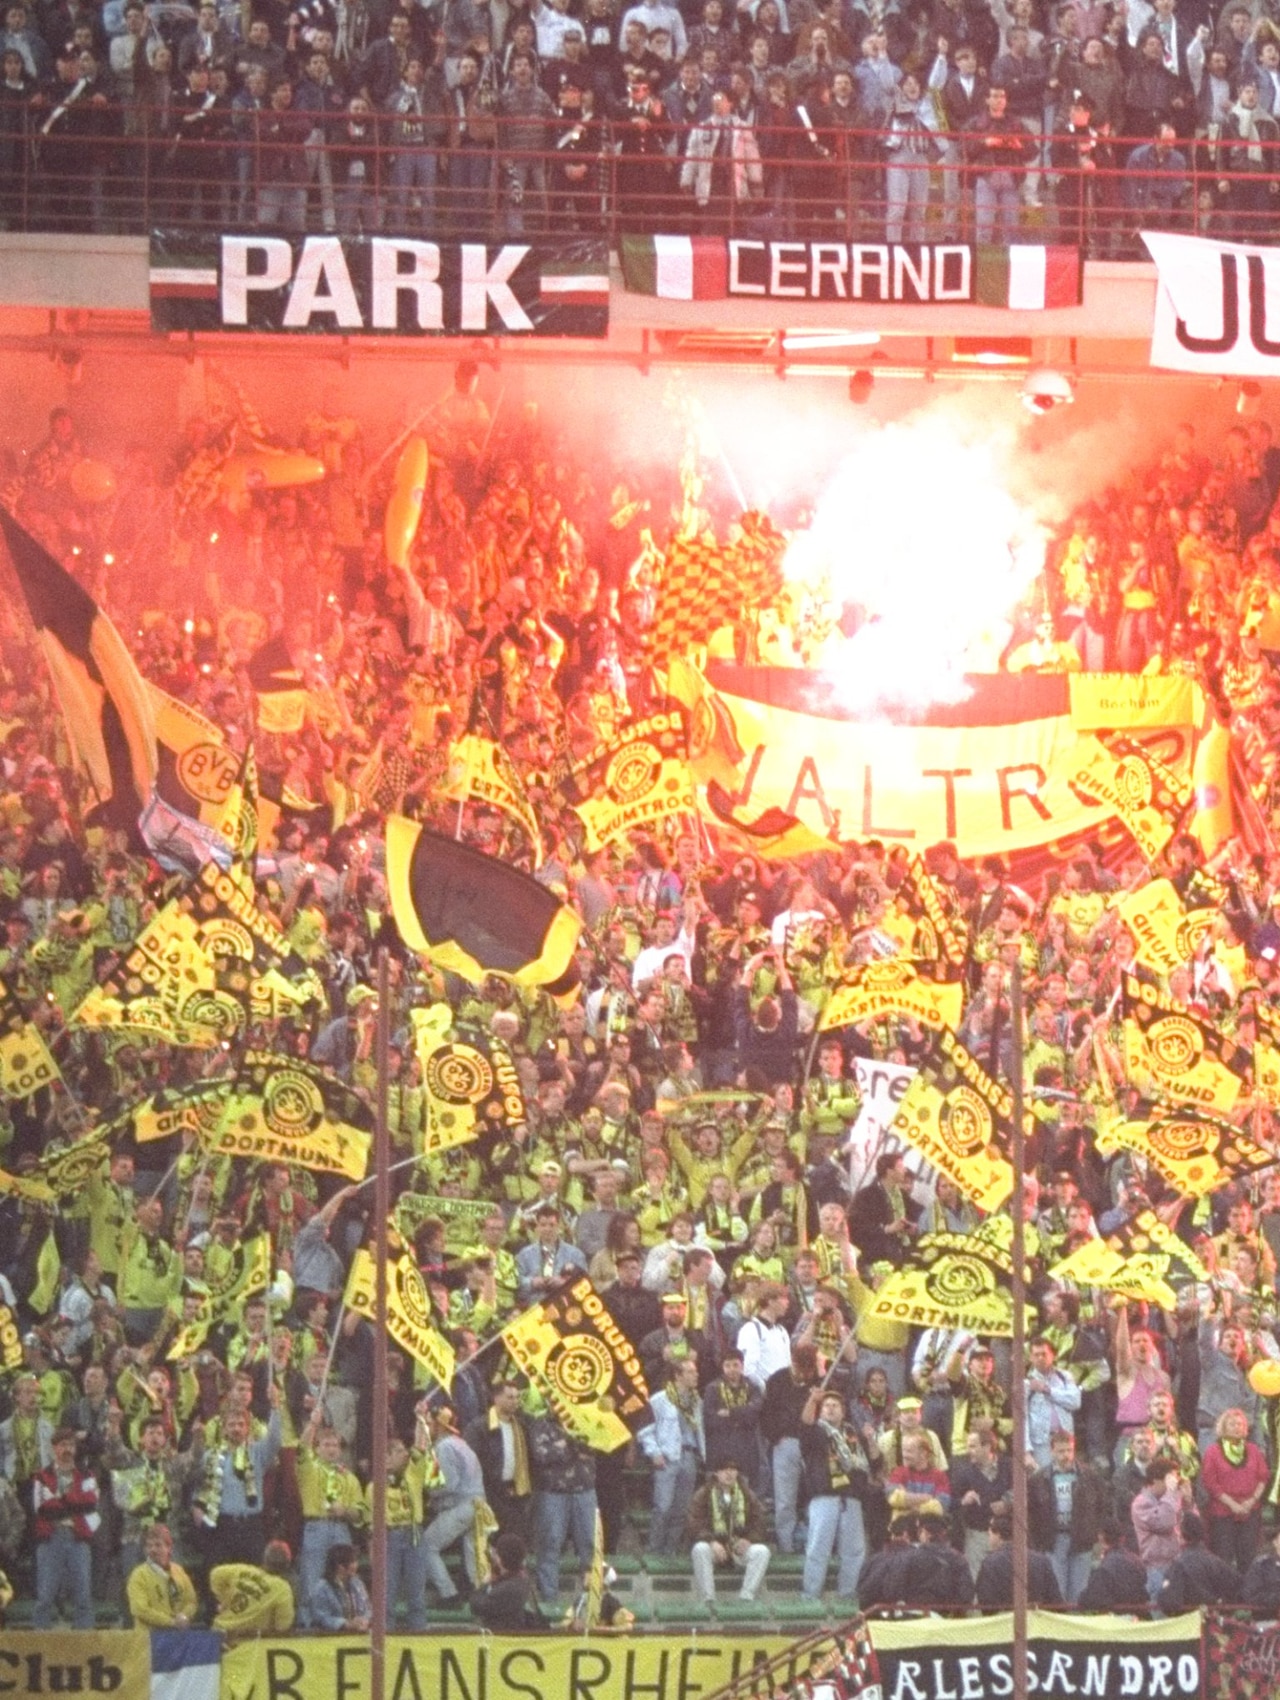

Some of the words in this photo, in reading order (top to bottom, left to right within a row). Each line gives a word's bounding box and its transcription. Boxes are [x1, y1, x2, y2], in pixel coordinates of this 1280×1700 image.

[220, 235, 536, 331] PARK
[728, 239, 973, 300] CERANO
[188, 751, 235, 792] BVB
[202, 860, 292, 958] BORUSSIA
[829, 993, 942, 1025] DORTMUND
[875, 1300, 1012, 1332] DORTMUND
[0, 1649, 123, 1693] Club
